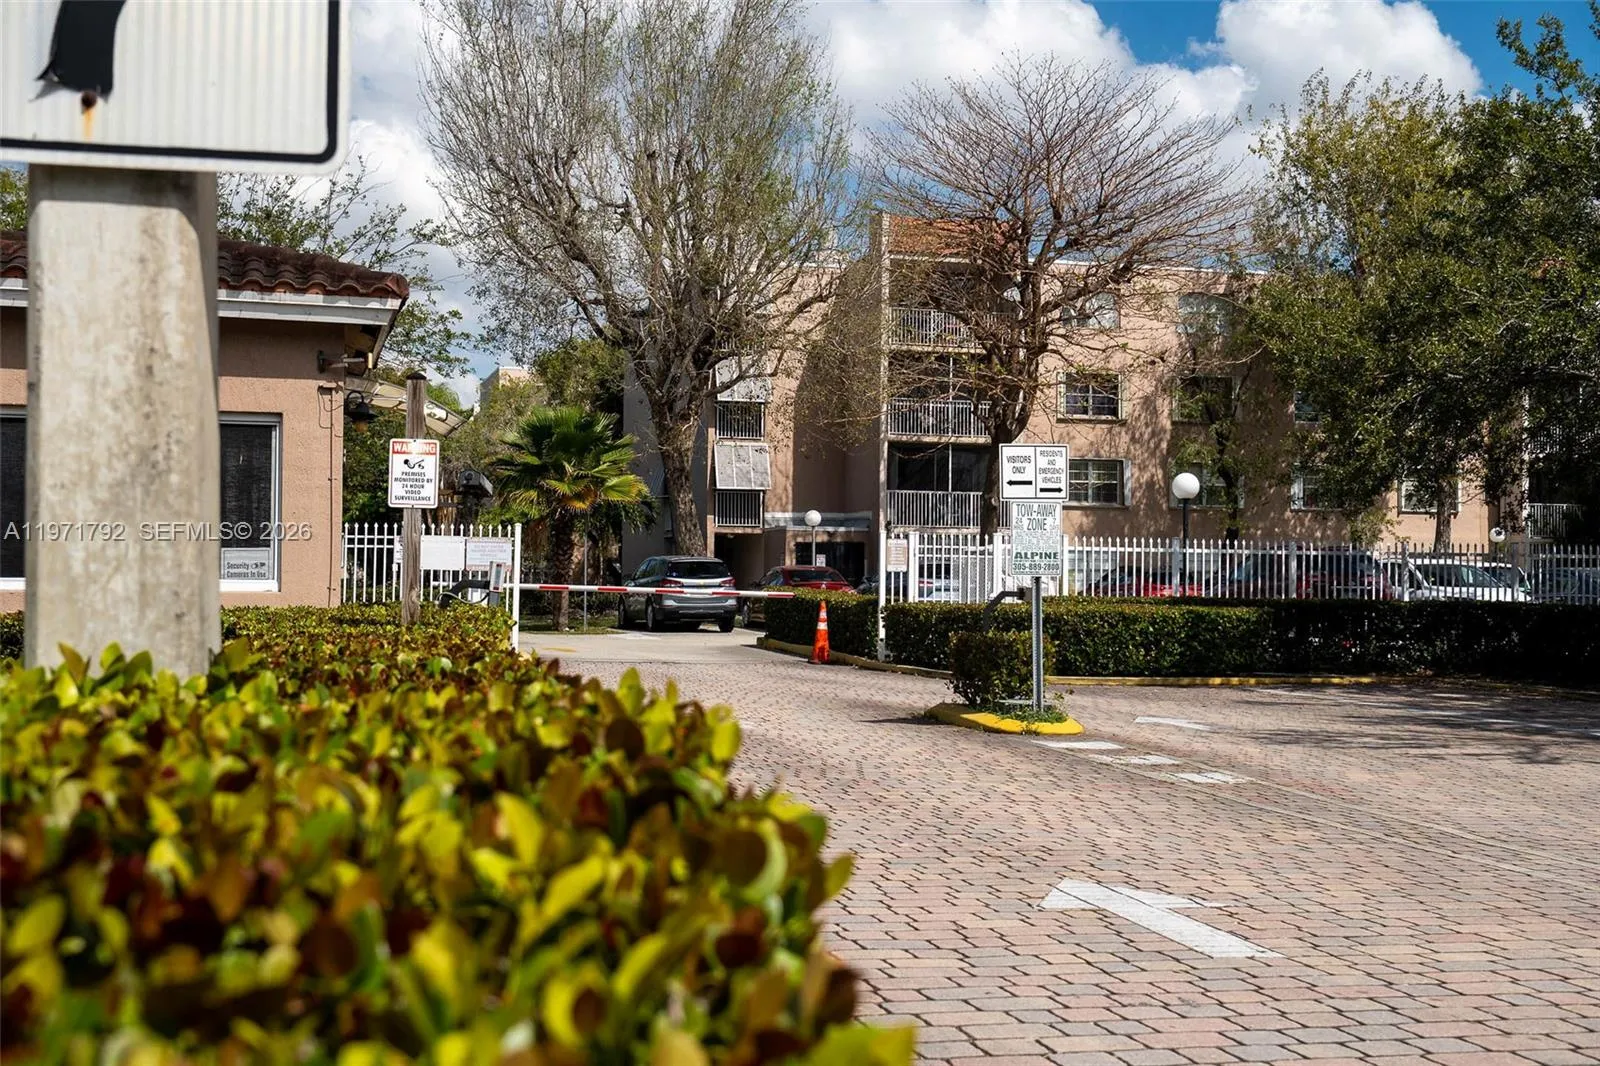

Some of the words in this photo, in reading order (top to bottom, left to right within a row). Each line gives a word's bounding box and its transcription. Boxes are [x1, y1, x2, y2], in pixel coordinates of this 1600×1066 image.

[393, 442, 436, 453] WARING
[1006, 455, 1031, 464] VISITORS
[1011, 465, 1026, 474] ONLY
[1016, 503, 1057, 517] TOW-AWAY
[1026, 517, 1047, 531] ZONE
[1014, 551, 1059, 560] ALPINE
[226, 561, 249, 570] Security
